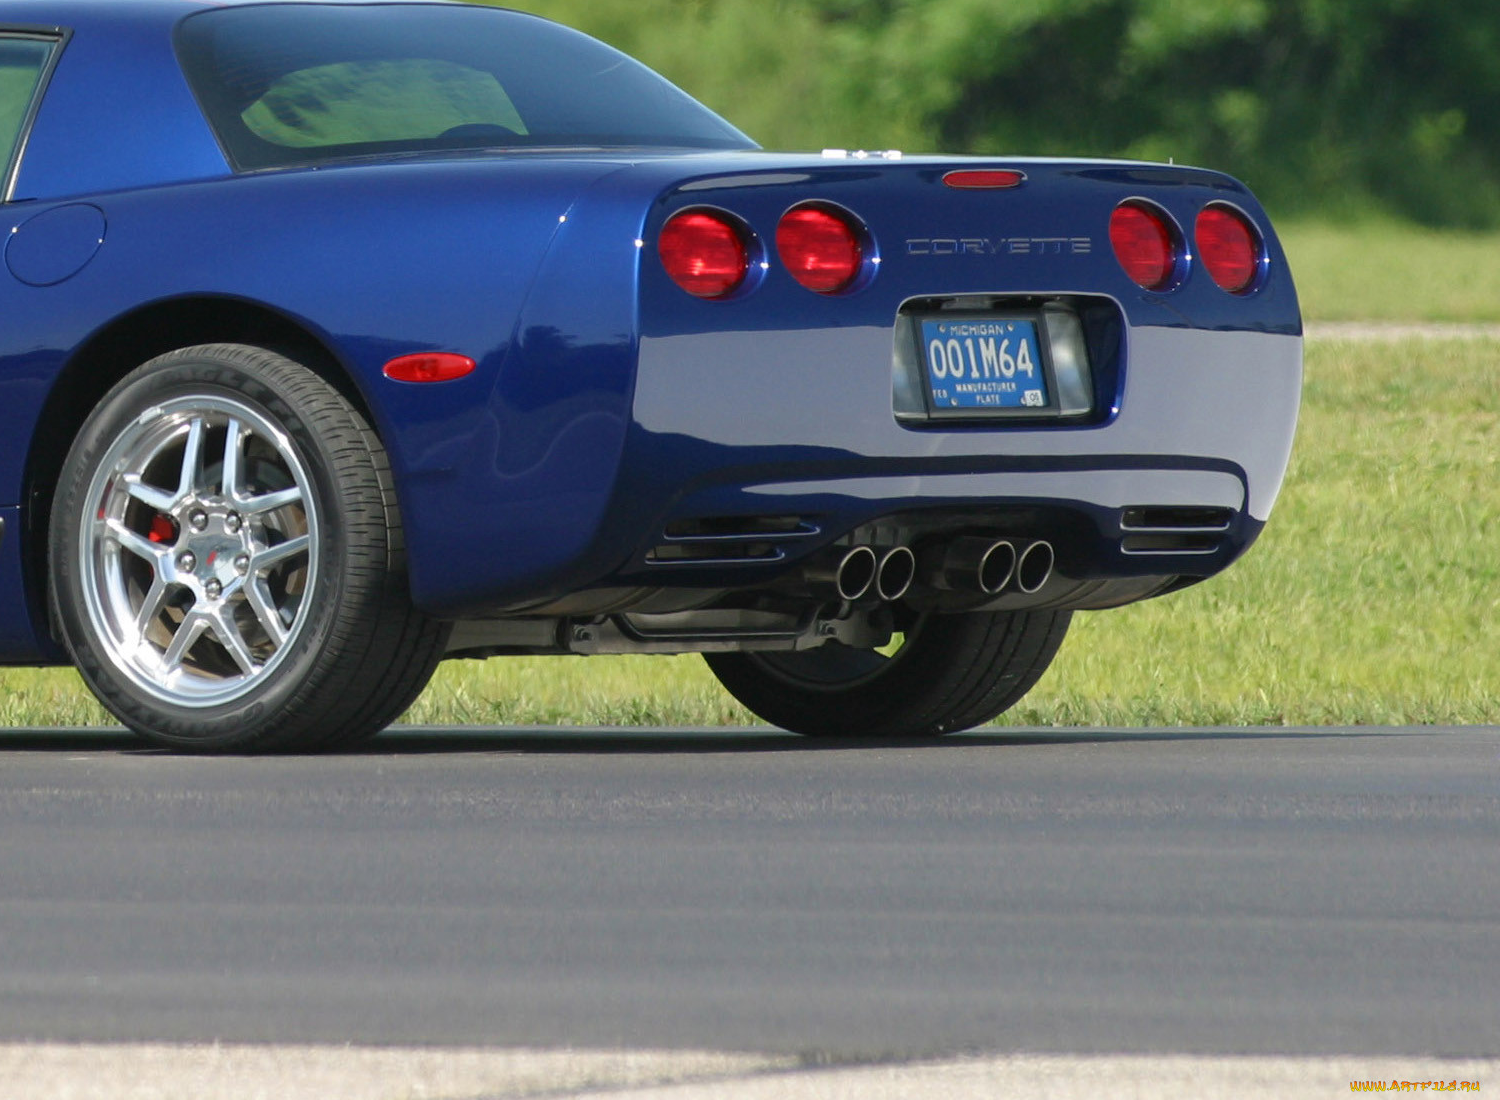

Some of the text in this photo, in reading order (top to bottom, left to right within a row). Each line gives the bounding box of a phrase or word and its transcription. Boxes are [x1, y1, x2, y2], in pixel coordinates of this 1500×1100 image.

[906, 238, 1091, 255] CORVETTE
[950, 324, 1004, 336] MICHIGAN
[929, 337, 1034, 380] 001M64
[955, 382, 1016, 394] MANUFACTURER
[976, 394, 1001, 405] PLATE
